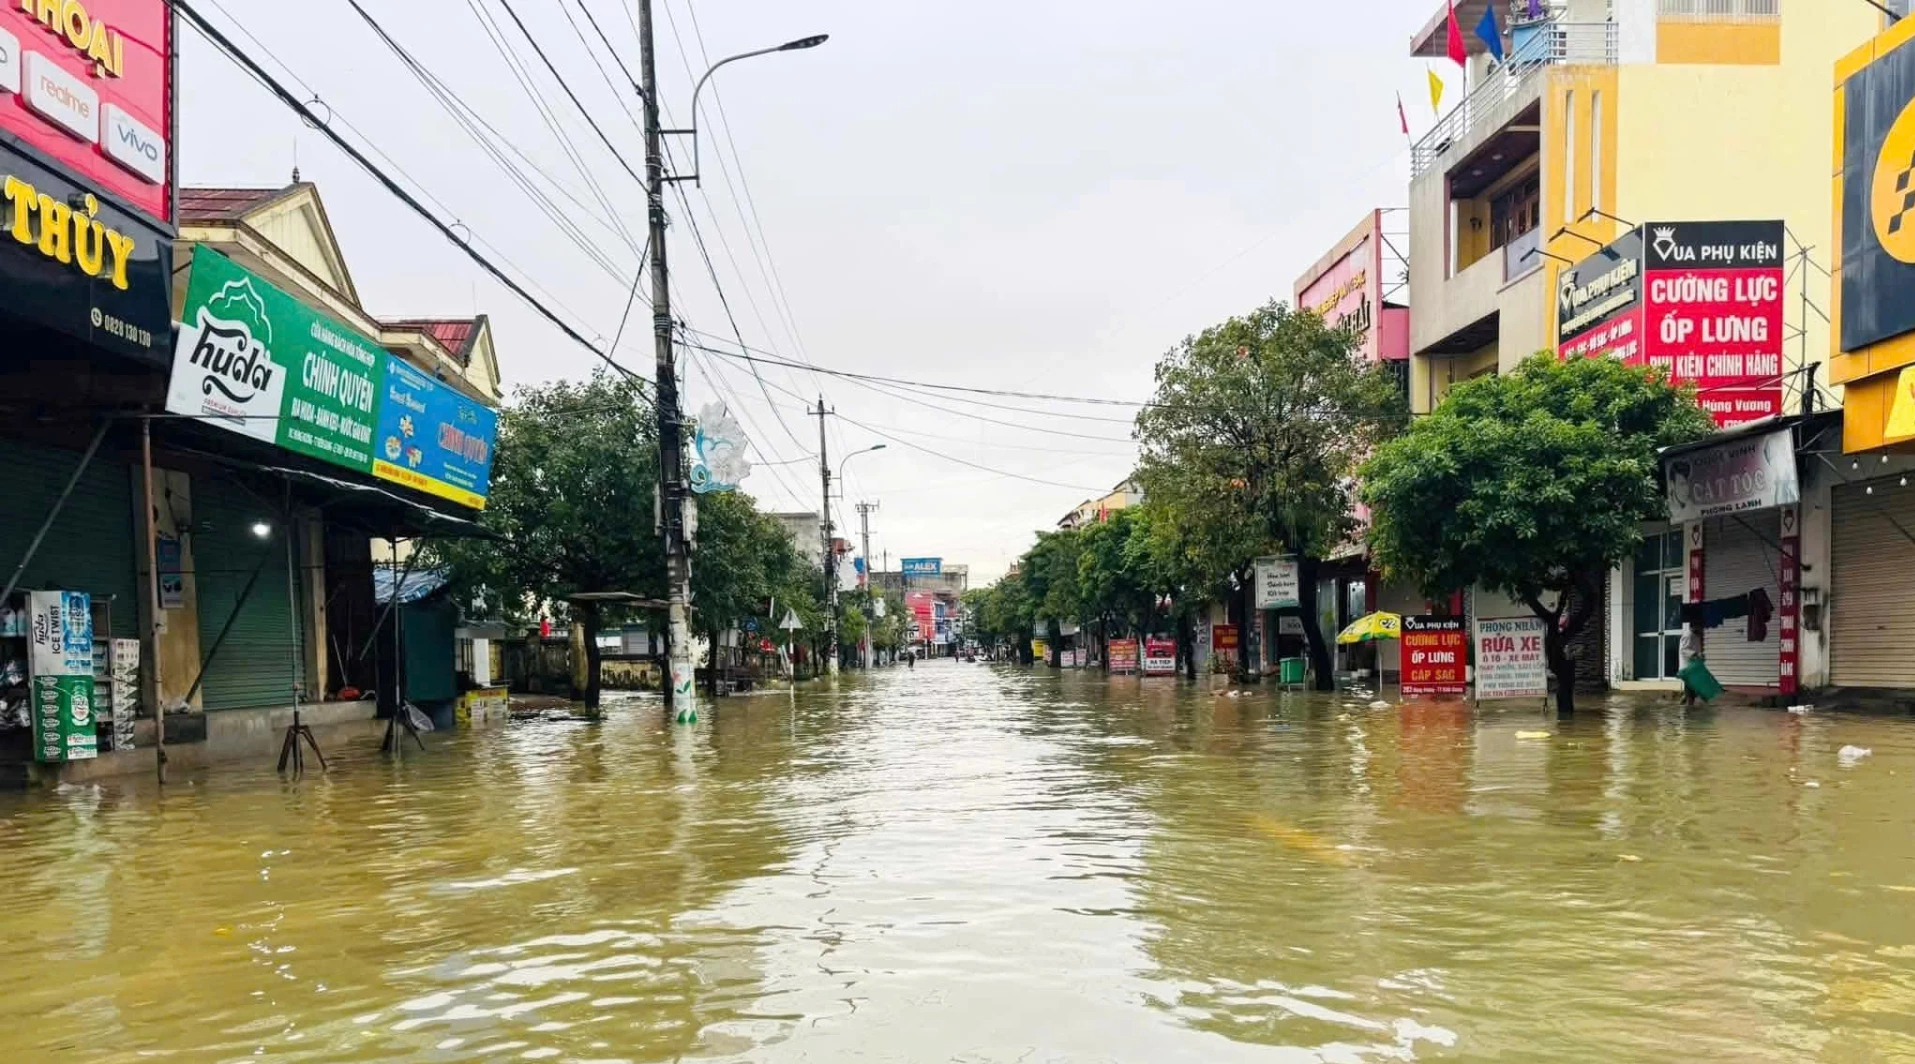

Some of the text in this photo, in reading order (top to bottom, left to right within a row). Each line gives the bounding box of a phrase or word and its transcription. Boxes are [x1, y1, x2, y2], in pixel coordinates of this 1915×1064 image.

[22, 0, 122, 79] HOẠI
[40, 73, 90, 118] realme
[117, 123, 158, 161] vivo
[5, 175, 134, 290] THỦY
[1701, 245, 1734, 265] PHỤ
[1740, 240, 1777, 265] KIỆN
[1651, 273, 1777, 306] CƯỜNG LỰC
[1661, 309, 1693, 344] ỐP
[1702, 316, 1767, 342] LƯNG
[190, 315, 273, 392] huda
[1676, 351, 1703, 378] KIỆN
[1707, 349, 1743, 376] CHÍNH
[1746, 349, 1778, 376] HÃNG
[303, 350, 339, 398] CHÍNH
[914, 562, 937, 571] ALEX
[51, 606, 60, 654] ICE TWIST
[1481, 633, 1540, 653] RỬA XE
[1412, 649, 1455, 664] ỐP LƯNG
